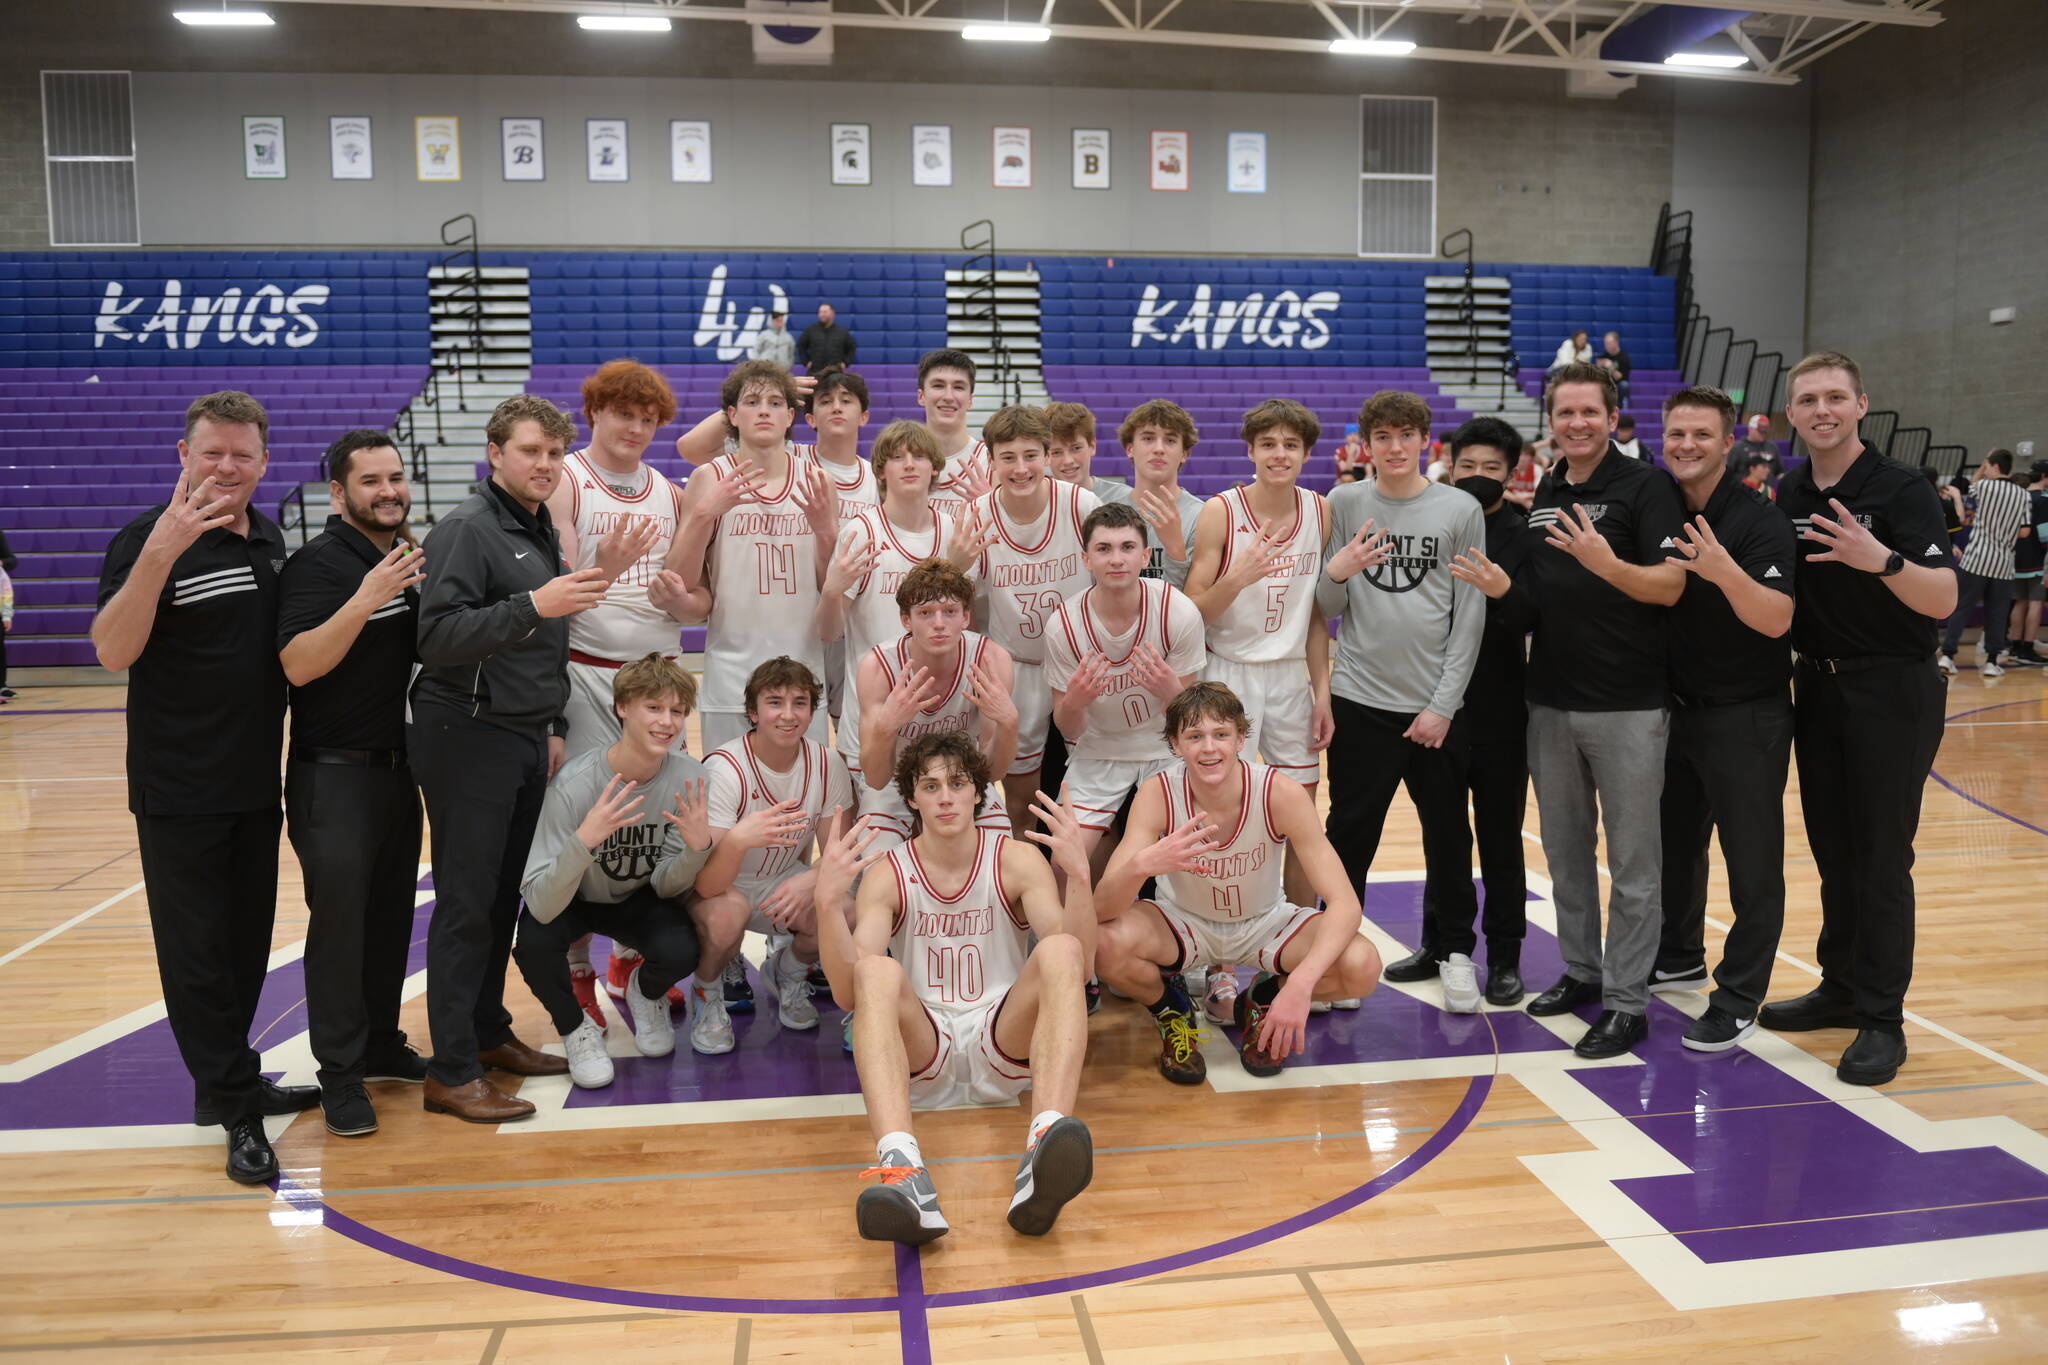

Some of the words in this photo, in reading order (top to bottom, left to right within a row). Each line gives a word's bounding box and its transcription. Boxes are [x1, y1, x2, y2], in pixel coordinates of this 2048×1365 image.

[1084, 154, 1100, 174] B
[95, 279, 331, 350] KANGS
[1131, 284, 1341, 350] KANGS
[729, 513, 796, 536] MOUNT
[1383, 556, 1432, 569] ETBALL
[1421, 536, 1439, 557] SI
[755, 542, 797, 595] 14
[993, 559, 1059, 588] MOUNT
[1060, 553, 1077, 580] SI
[1264, 585, 1289, 633] 5
[1212, 885, 1242, 918] 4
[914, 910, 981, 938] MOUNT
[928, 943, 984, 1002] 40
